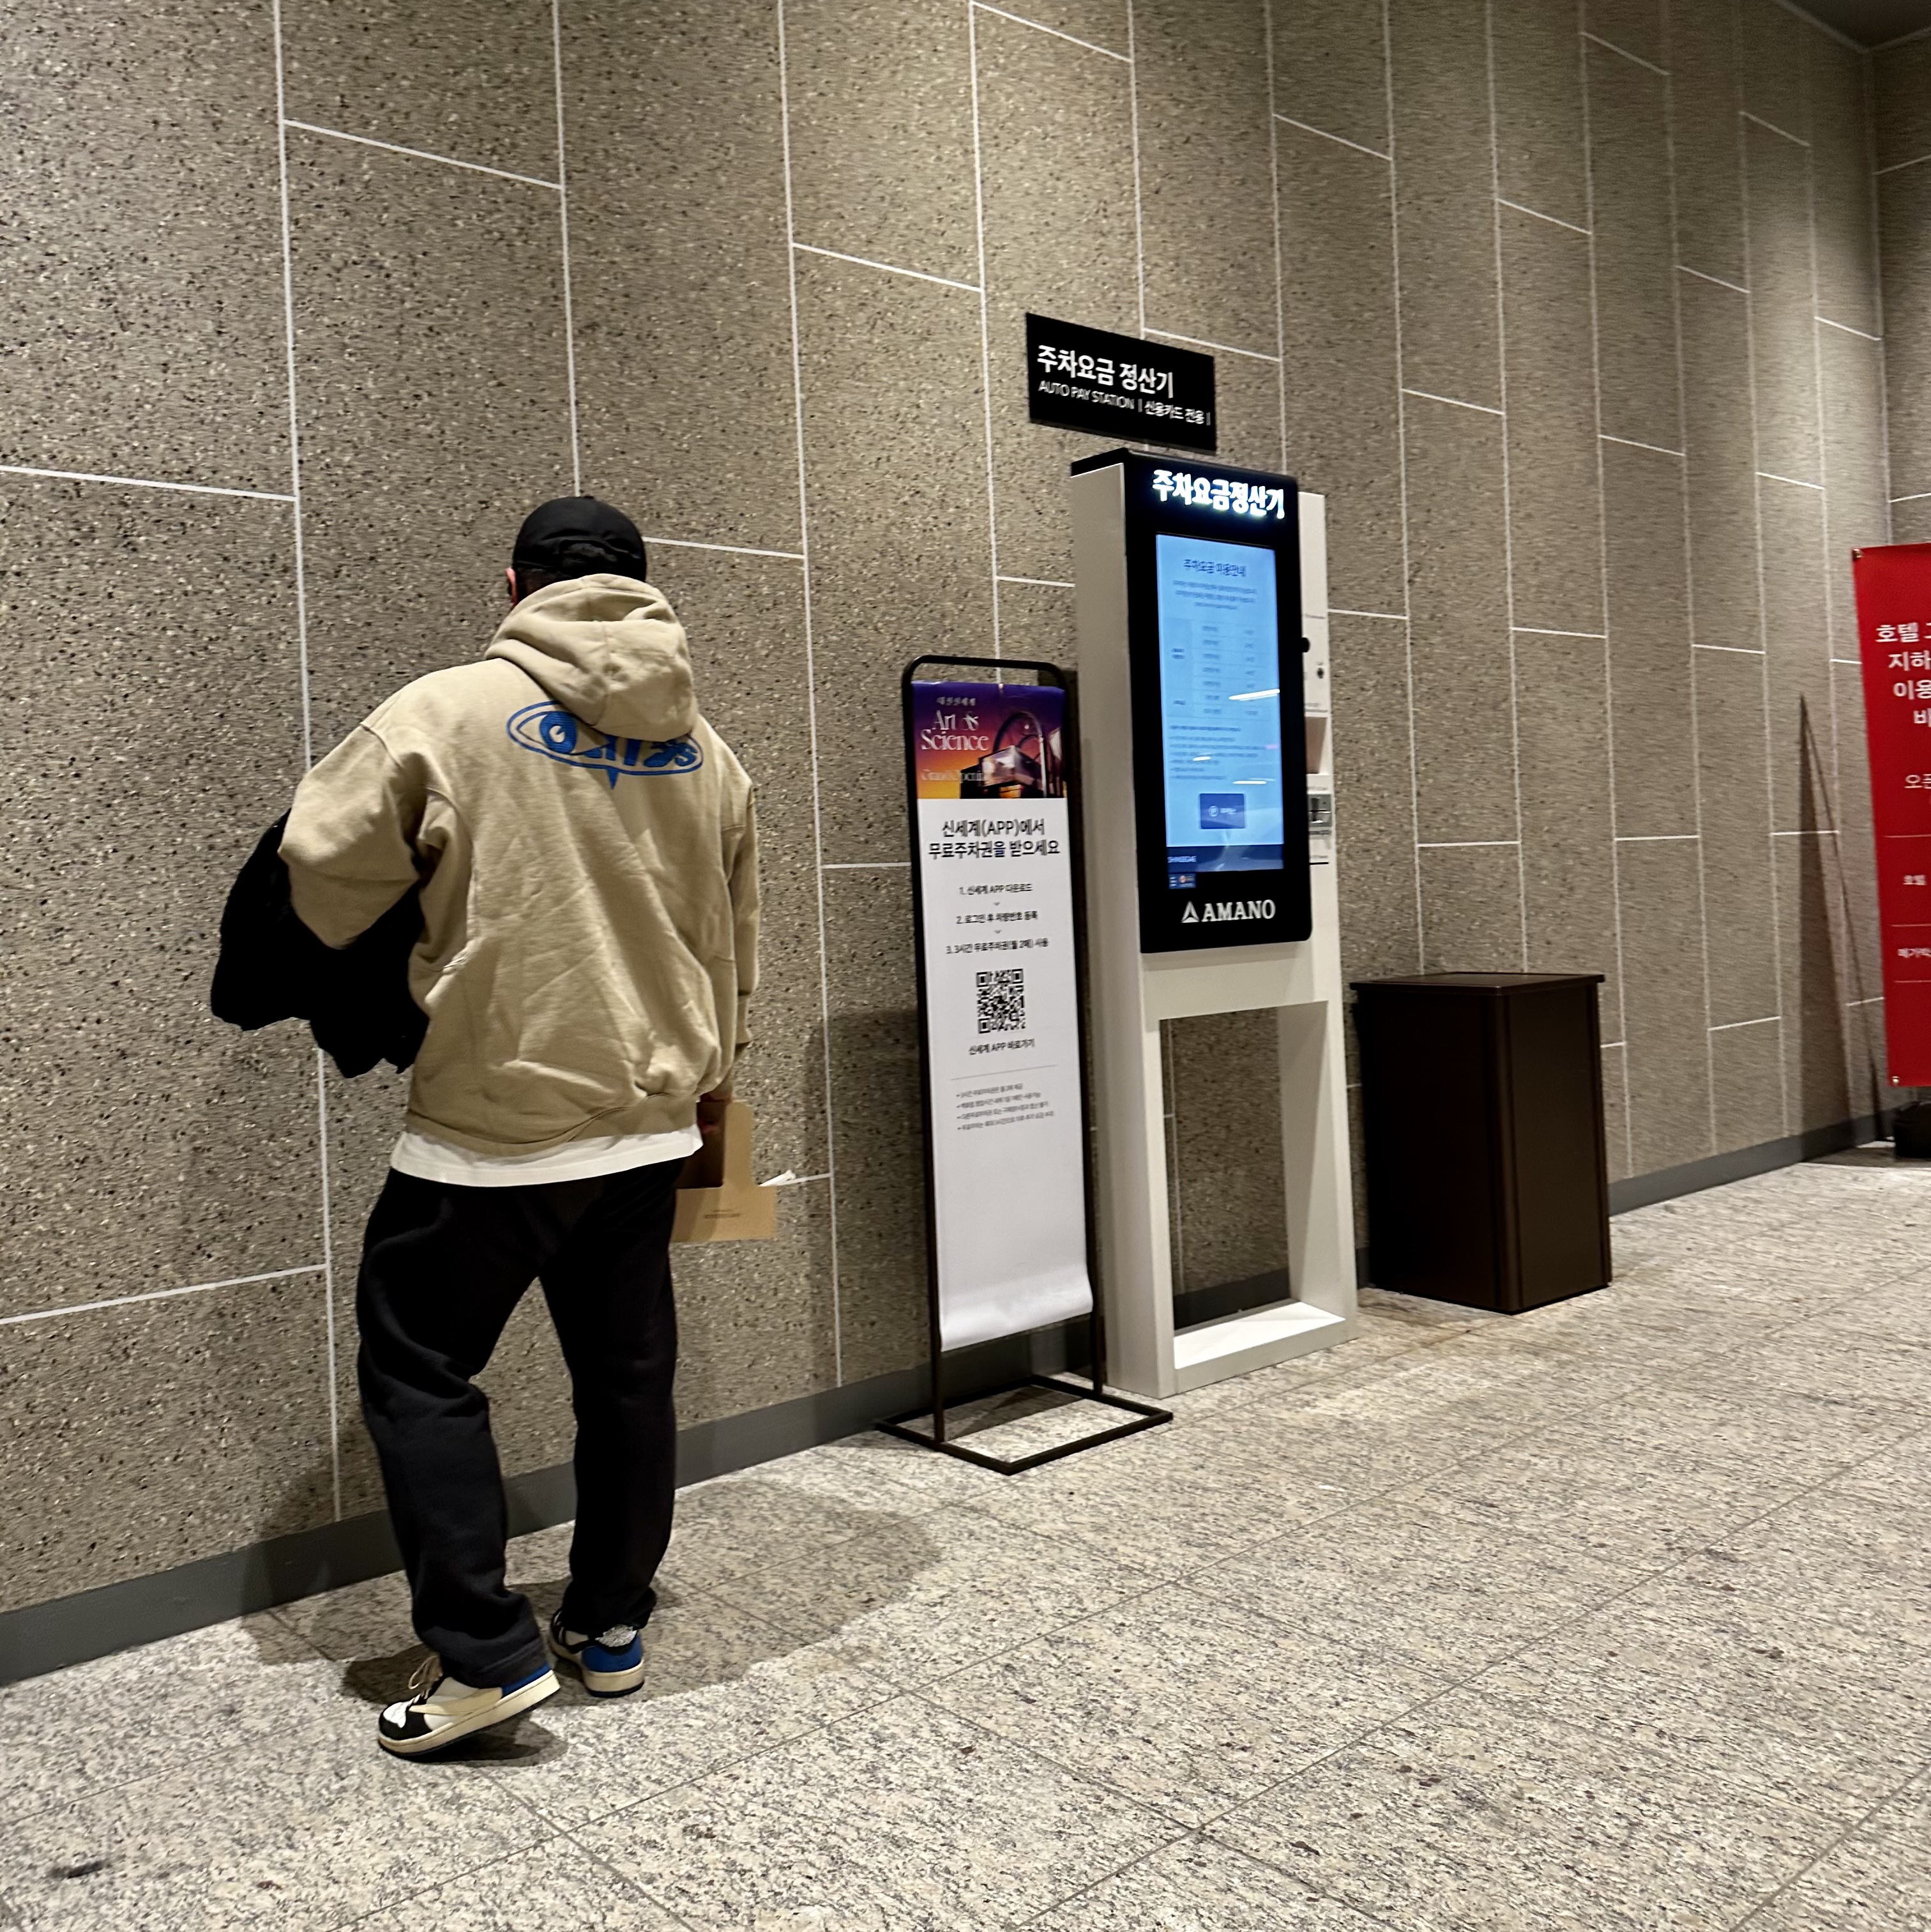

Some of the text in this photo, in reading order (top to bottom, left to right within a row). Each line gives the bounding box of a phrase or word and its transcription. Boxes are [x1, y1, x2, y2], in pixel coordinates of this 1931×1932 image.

[1037, 344, 1174, 399] 주차요금 정산기
[1038, 380, 1205, 425] AUTO PAY STATION 신용카드 전용
[1152, 469, 1285, 519] 주차요금정산기
[1875, 622, 1920, 643] 호텔
[932, 710, 957, 730] Art
[920, 729, 989, 751] Science
[942, 818, 1045, 838] 신세계(APP)에서
[928, 839, 1061, 860] 무료주차권을 받으세요
[1201, 899, 1276, 923] AMANO
